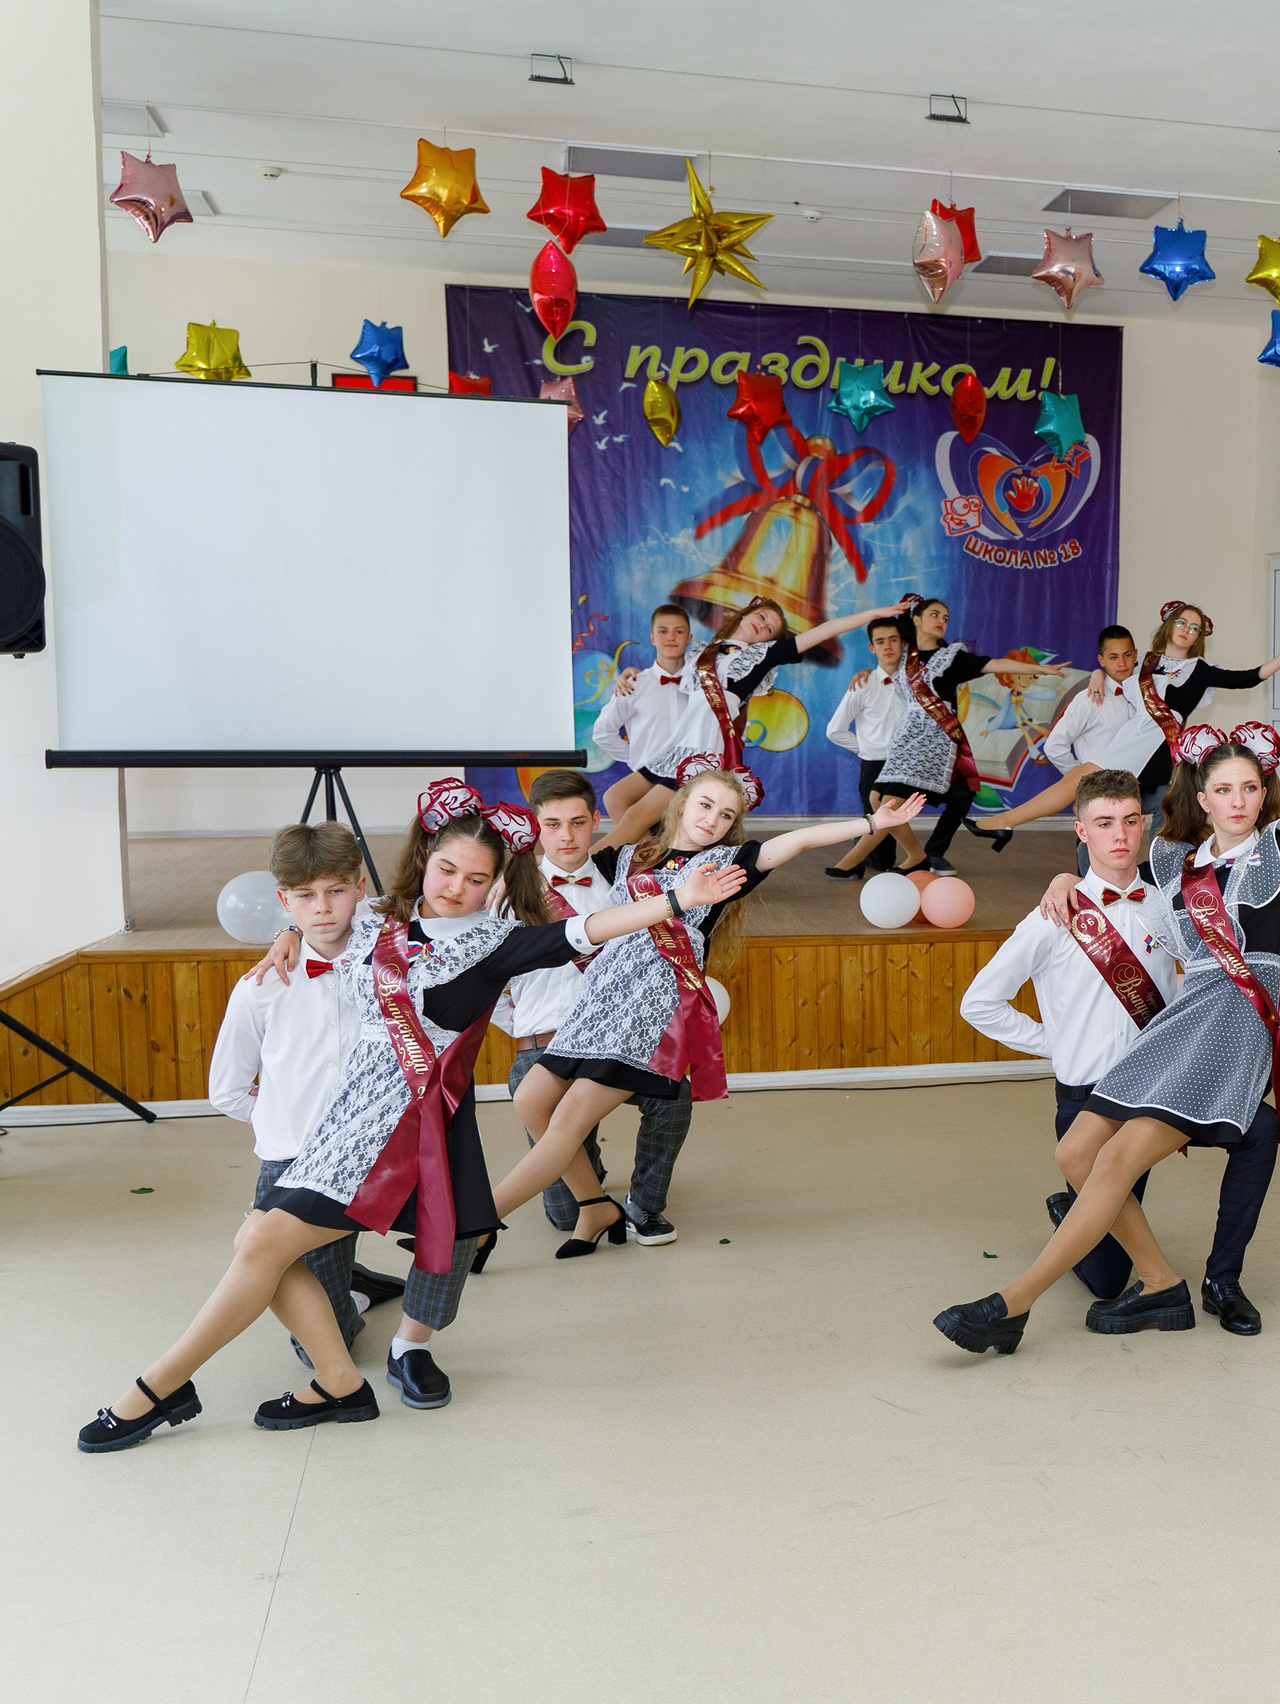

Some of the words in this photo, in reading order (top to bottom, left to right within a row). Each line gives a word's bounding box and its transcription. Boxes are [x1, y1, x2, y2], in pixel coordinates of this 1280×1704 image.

[541, 320, 597, 376] С
[963, 534, 1034, 569] ШКОЛА
[1035, 548, 1059, 569] №
[1058, 539, 1083, 564] 18
[1189, 889, 1252, 980] Выпускница
[377, 963, 429, 1076] Выпускница
